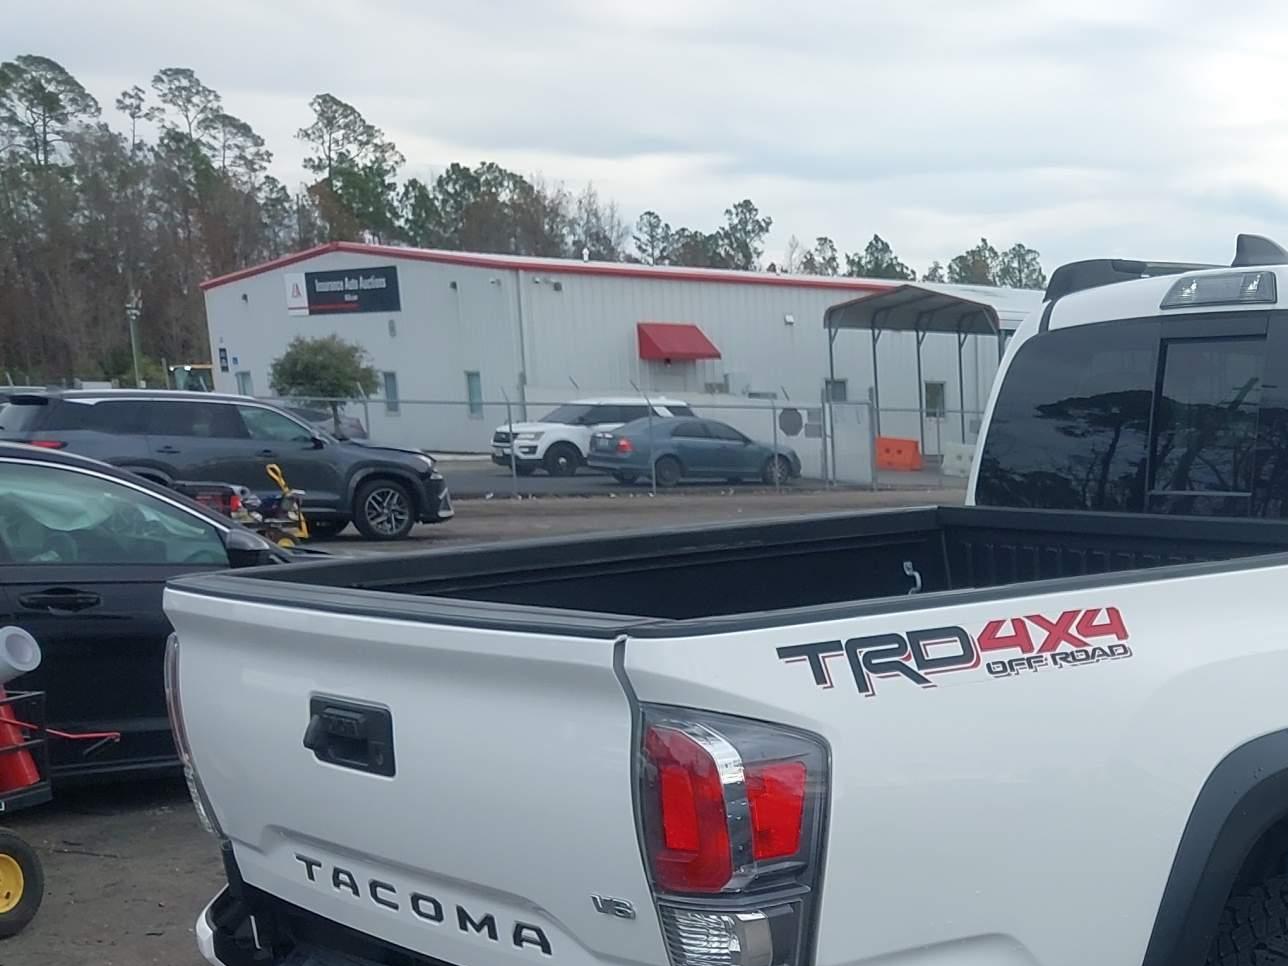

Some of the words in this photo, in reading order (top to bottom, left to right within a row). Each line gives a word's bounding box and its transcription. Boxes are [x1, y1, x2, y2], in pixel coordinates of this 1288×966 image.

[776, 625, 981, 698] TRD
[985, 652, 1050, 679] OFF
[1052, 642, 1134, 670] ROAD
[294, 851, 553, 956] TACOMA
[589, 893, 637, 921] V6
